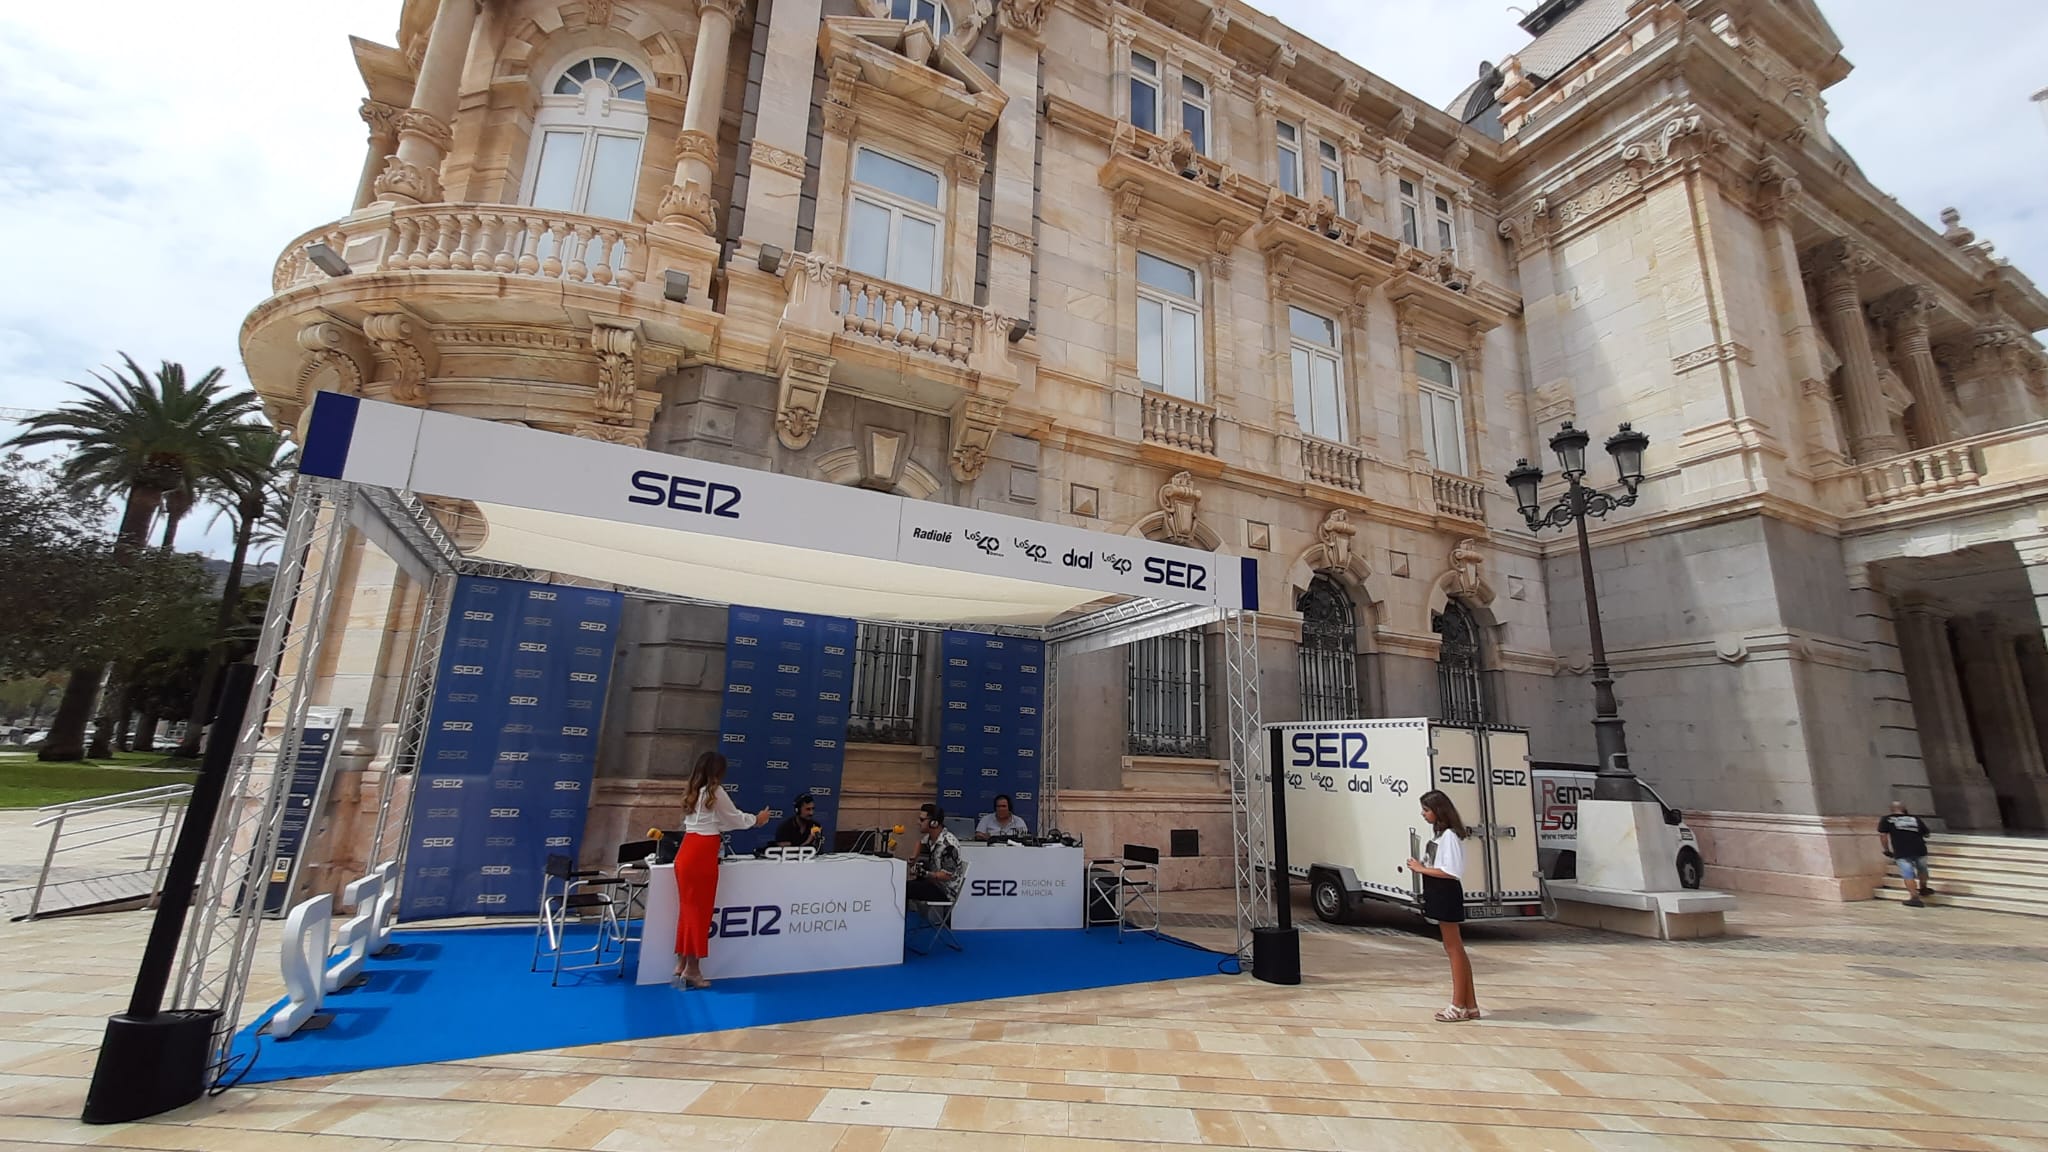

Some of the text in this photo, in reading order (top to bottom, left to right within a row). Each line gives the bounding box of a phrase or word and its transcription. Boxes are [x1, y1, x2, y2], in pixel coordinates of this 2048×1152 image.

[628, 470, 741, 518] SER
[913, 527, 952, 543] Radiolé
[977, 536, 1000, 555] 40
[1025, 544, 1047, 562] 40
[1112, 558, 1132, 575] 40
[1144, 557, 1207, 591] SER
[529, 591, 557, 600] SER
[464, 611, 494, 621] SER
[580, 621, 607, 631] SER
[736, 637, 758, 645] SER
[519, 642, 547, 652] SER
[825, 646, 845, 654] SER
[452, 665, 483, 674] SER
[778, 665, 800, 673] SER
[1020, 665, 1037, 673] SER
[570, 672, 597, 681] SER
[729, 685, 752, 693] SER
[510, 696, 538, 705] SER
[820, 692, 840, 700] SER
[949, 701, 967, 709] SER
[772, 712, 795, 720] SER
[442, 721, 473, 730] SER
[562, 726, 588, 735] SER
[723, 734, 746, 742] SER
[814, 740, 836, 748] SER
[1292, 732, 1369, 769] SER
[500, 752, 529, 761] SER
[767, 761, 789, 769] SER
[1440, 766, 1475, 784] SER
[1492, 769, 1526, 786] SER
[433, 779, 464, 788] SER
[554, 781, 580, 790] SER
[1391, 779, 1409, 797] 40
[810, 787, 831, 795] SER
[490, 808, 520, 817] SER
[423, 837, 454, 847] SER
[546, 837, 571, 846] SER
[765, 847, 816, 863] SER
[481, 866, 511, 875] SER
[971, 880, 1017, 896] SER
[477, 894, 506, 903] SER
[790, 900, 872, 915] REGIÓN DE
[789, 920, 848, 934] MURCIA
